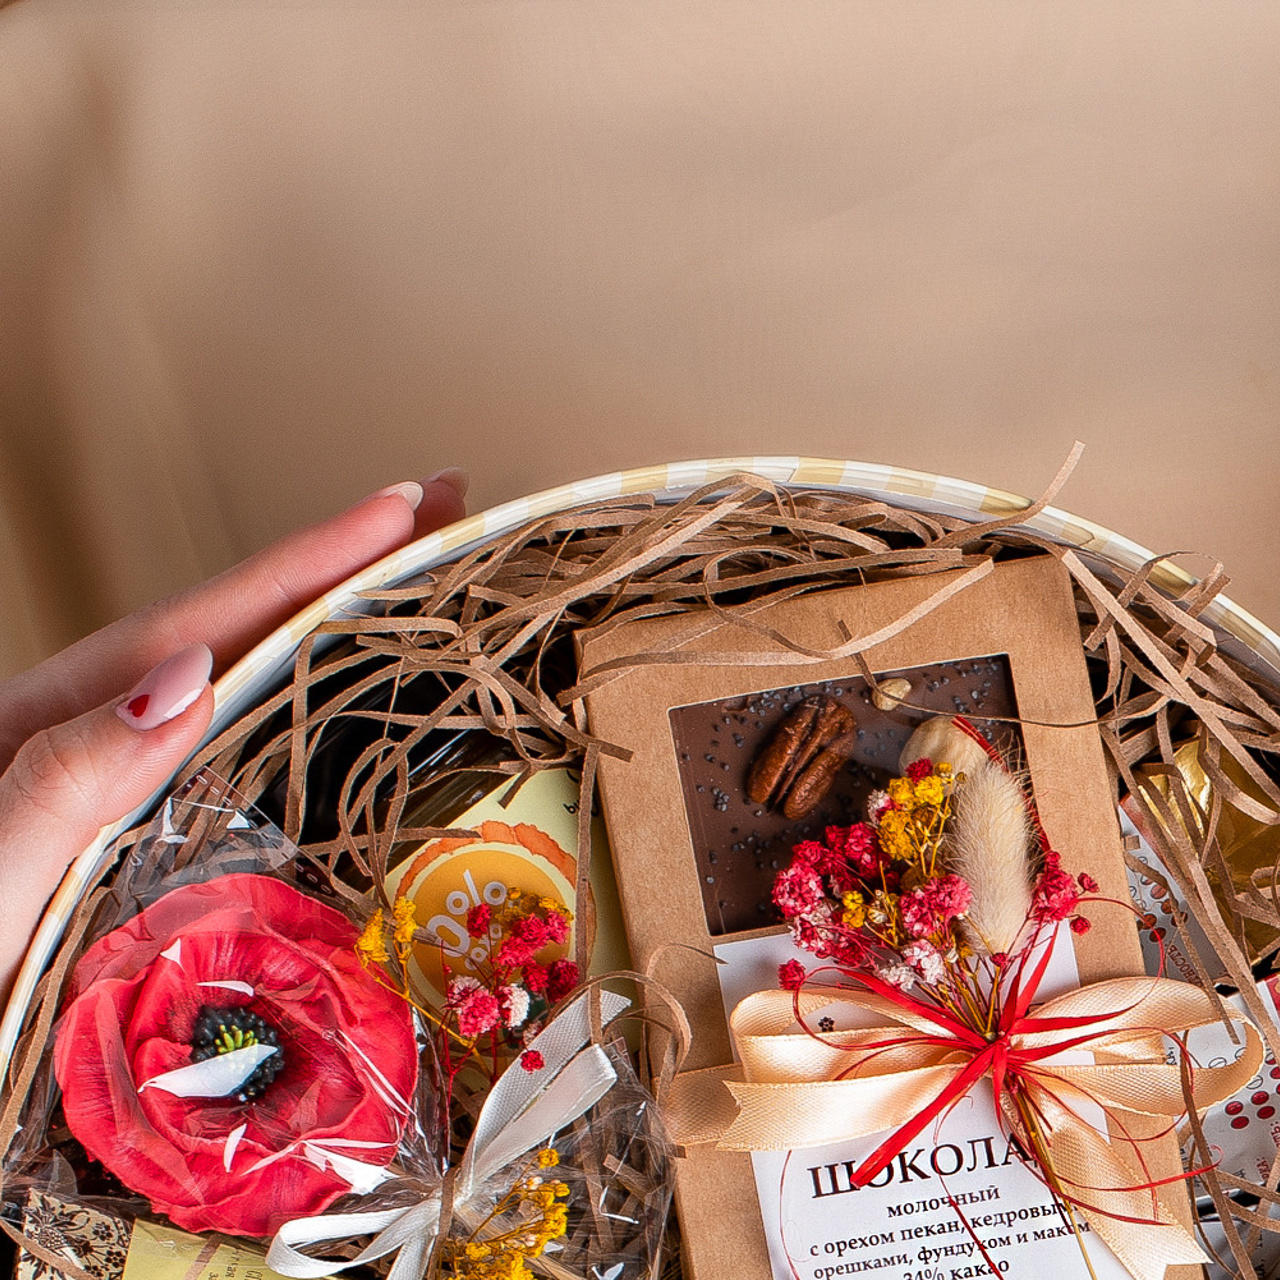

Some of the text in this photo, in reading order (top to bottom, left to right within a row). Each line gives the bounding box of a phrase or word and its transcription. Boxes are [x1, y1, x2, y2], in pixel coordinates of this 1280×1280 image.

[807, 1133, 1037, 1198] ШОКОЛА
[887, 1185, 1000, 1218] молочный
[810, 1244, 819, 1257] с
[824, 1231, 895, 1257] орехом
[900, 1219, 966, 1241] пекан,
[917, 1236, 1012, 1265] фундуком
[1017, 1231, 1029, 1244] и
[1033, 1221, 1092, 1242] маком
[950, 1259, 1010, 1280] какао
